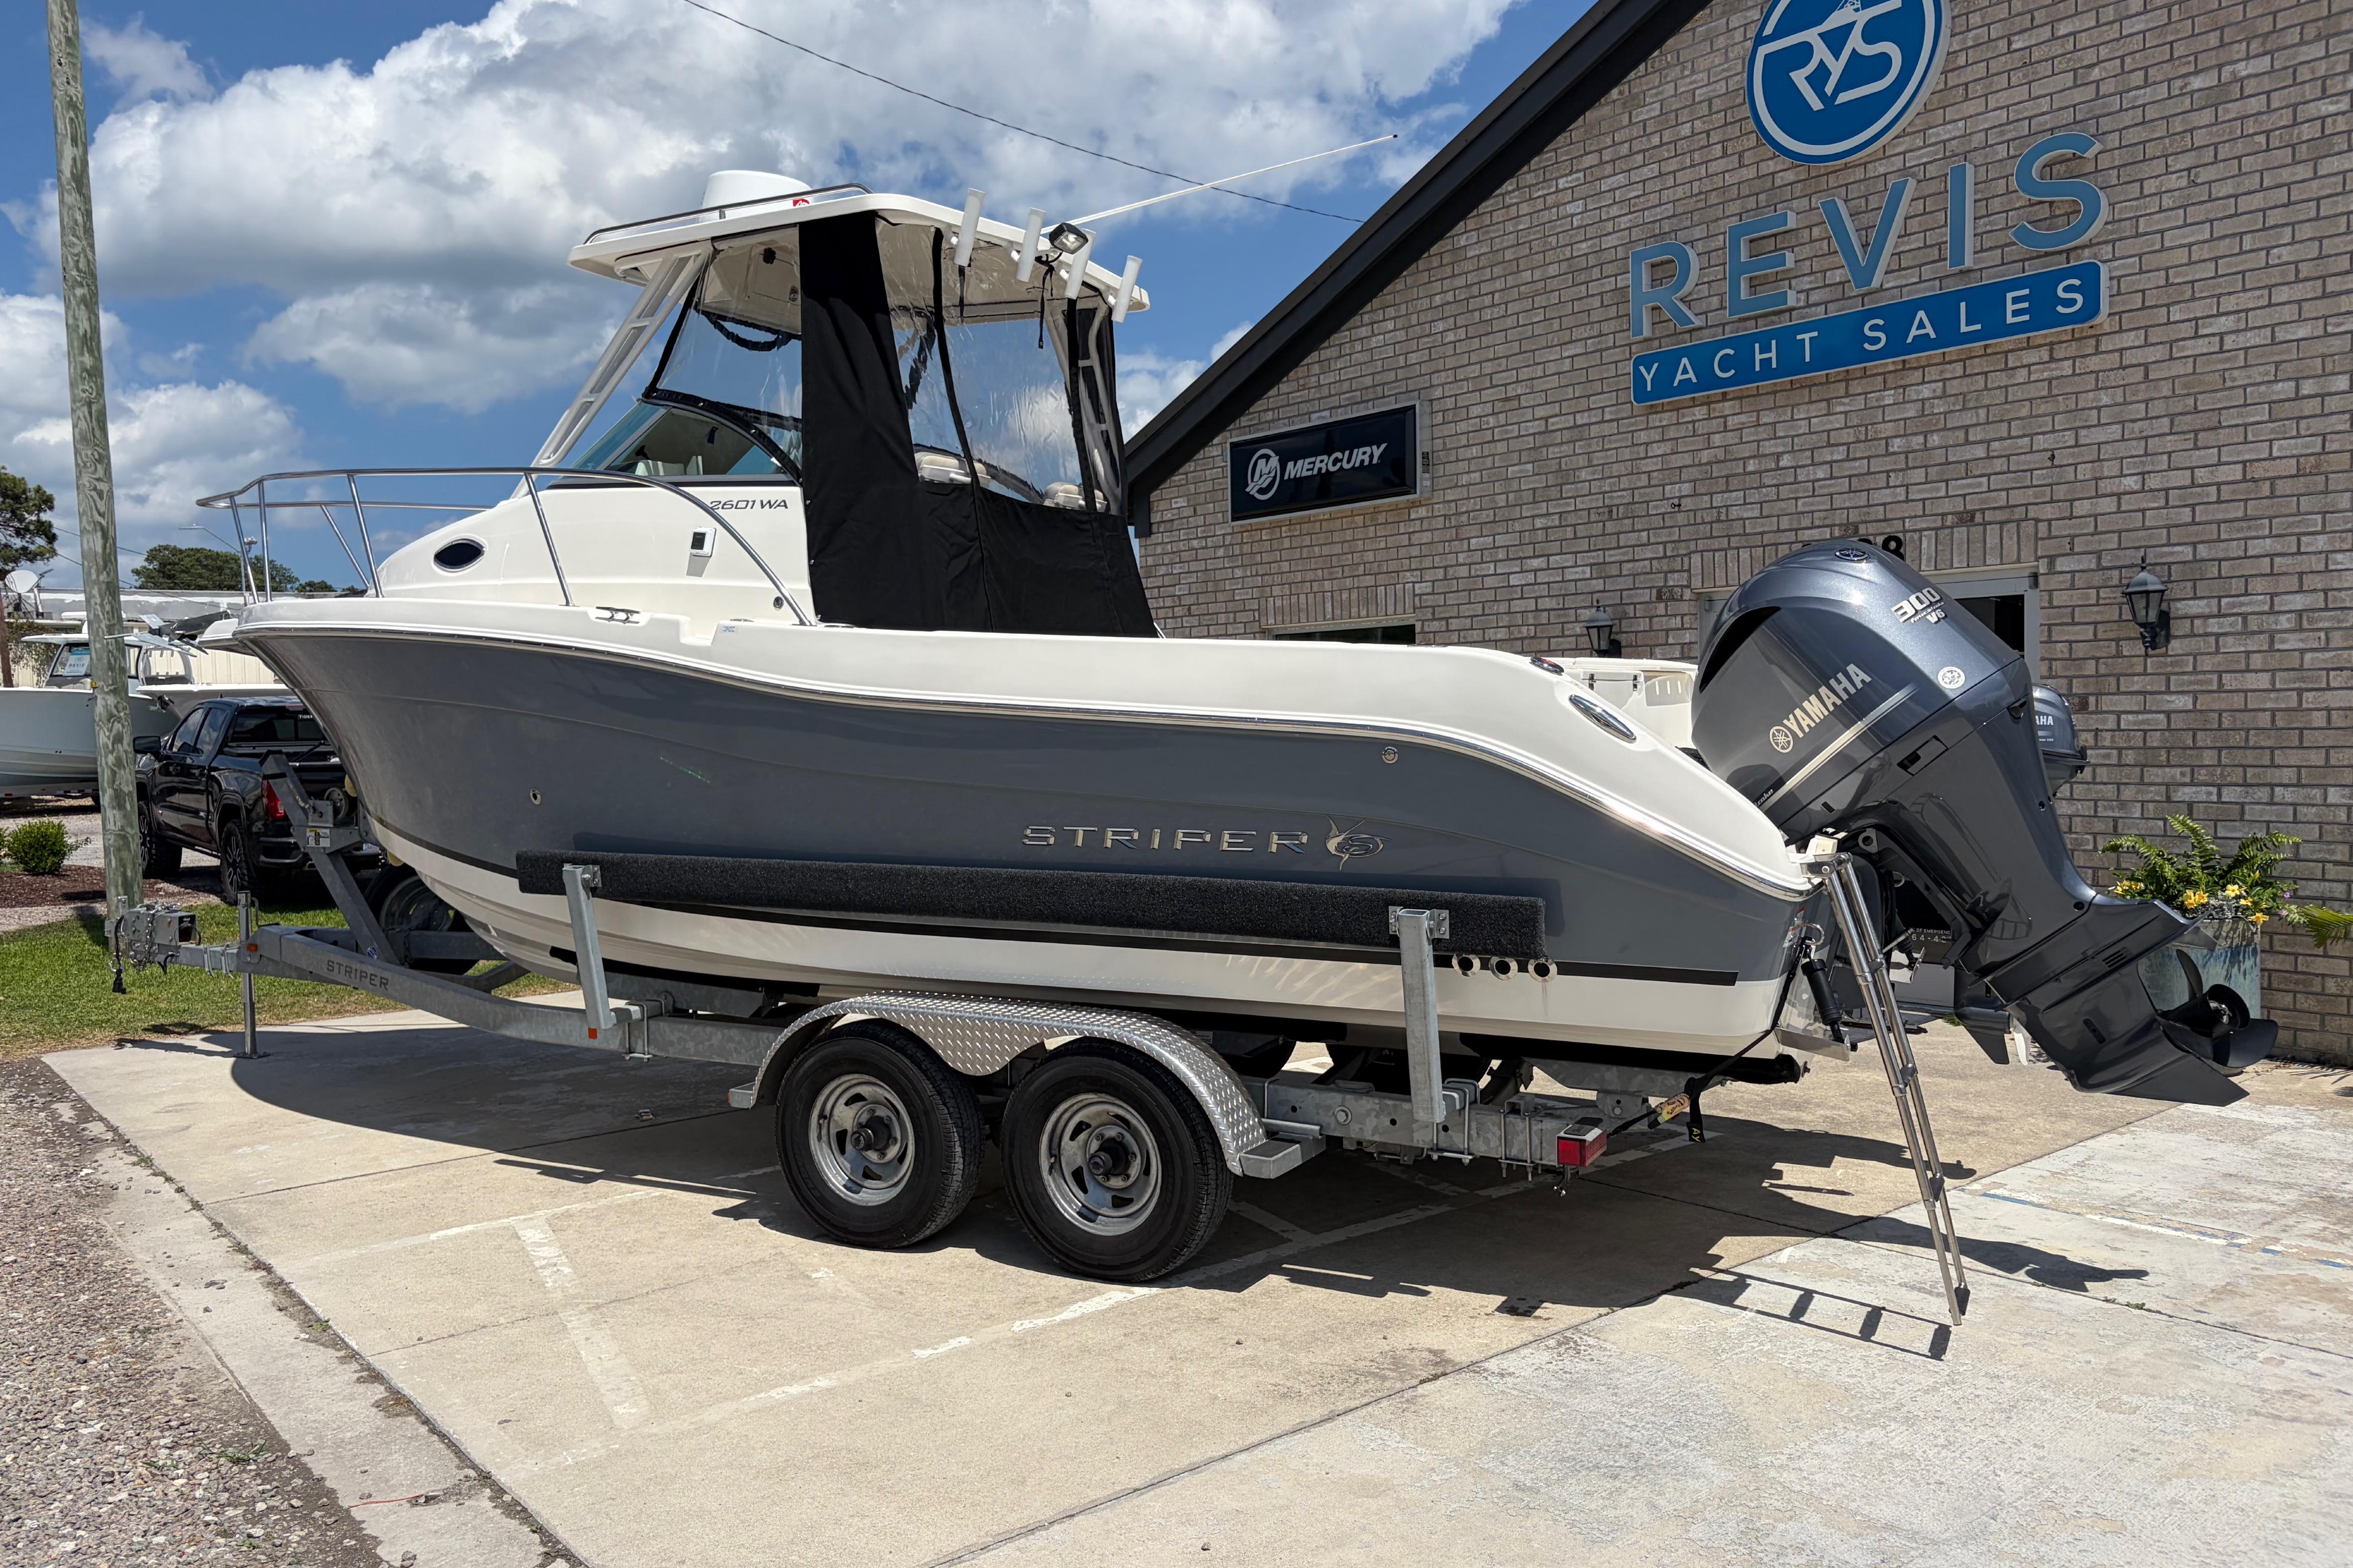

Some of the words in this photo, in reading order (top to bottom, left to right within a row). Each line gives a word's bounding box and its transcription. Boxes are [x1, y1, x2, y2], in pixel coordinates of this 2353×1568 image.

[1630, 131, 2110, 339] REVIS
[1638, 330, 1819, 392] YACHT
[1863, 278, 2084, 351] SALES
[1284, 443, 1388, 481] MERCURY
[710, 499, 755, 510] 2601
[760, 499, 789, 509] WA
[1891, 587, 1941, 623] 300
[1926, 609, 1946, 624] V6
[1782, 663, 1872, 740] YAMAHA
[2035, 715, 2054, 725] AHA
[1754, 788, 1774, 807] troke
[1022, 825, 1308, 855] STRIPER
[1911, 933, 1951, 943] 64-4
[326, 960, 389, 991] STRIPER
